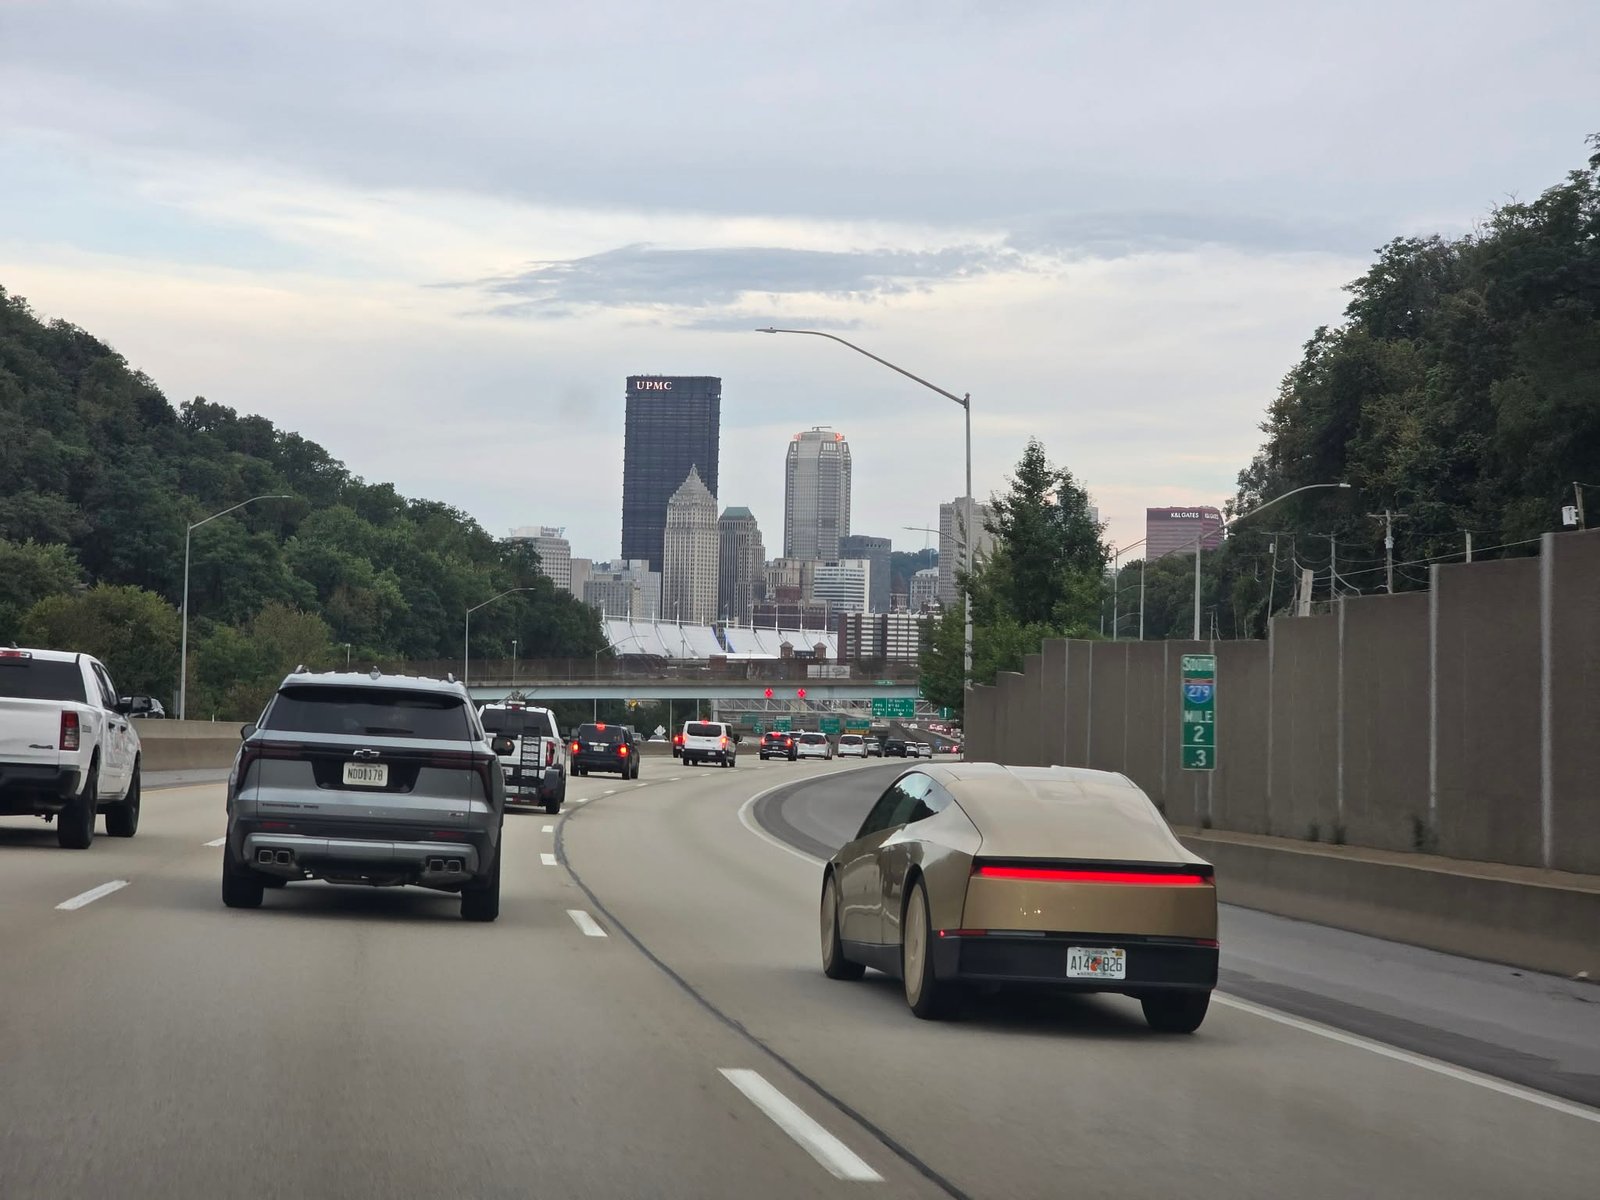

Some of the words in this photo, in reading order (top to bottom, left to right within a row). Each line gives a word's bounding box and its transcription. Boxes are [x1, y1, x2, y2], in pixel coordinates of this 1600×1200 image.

[636, 380, 672, 390] UPMC
[1183, 657, 1215, 671] SOUTH
[1188, 685, 1210, 697] 279
[1184, 710, 1214, 723] MILE
[1193, 726, 1204, 742] 2
